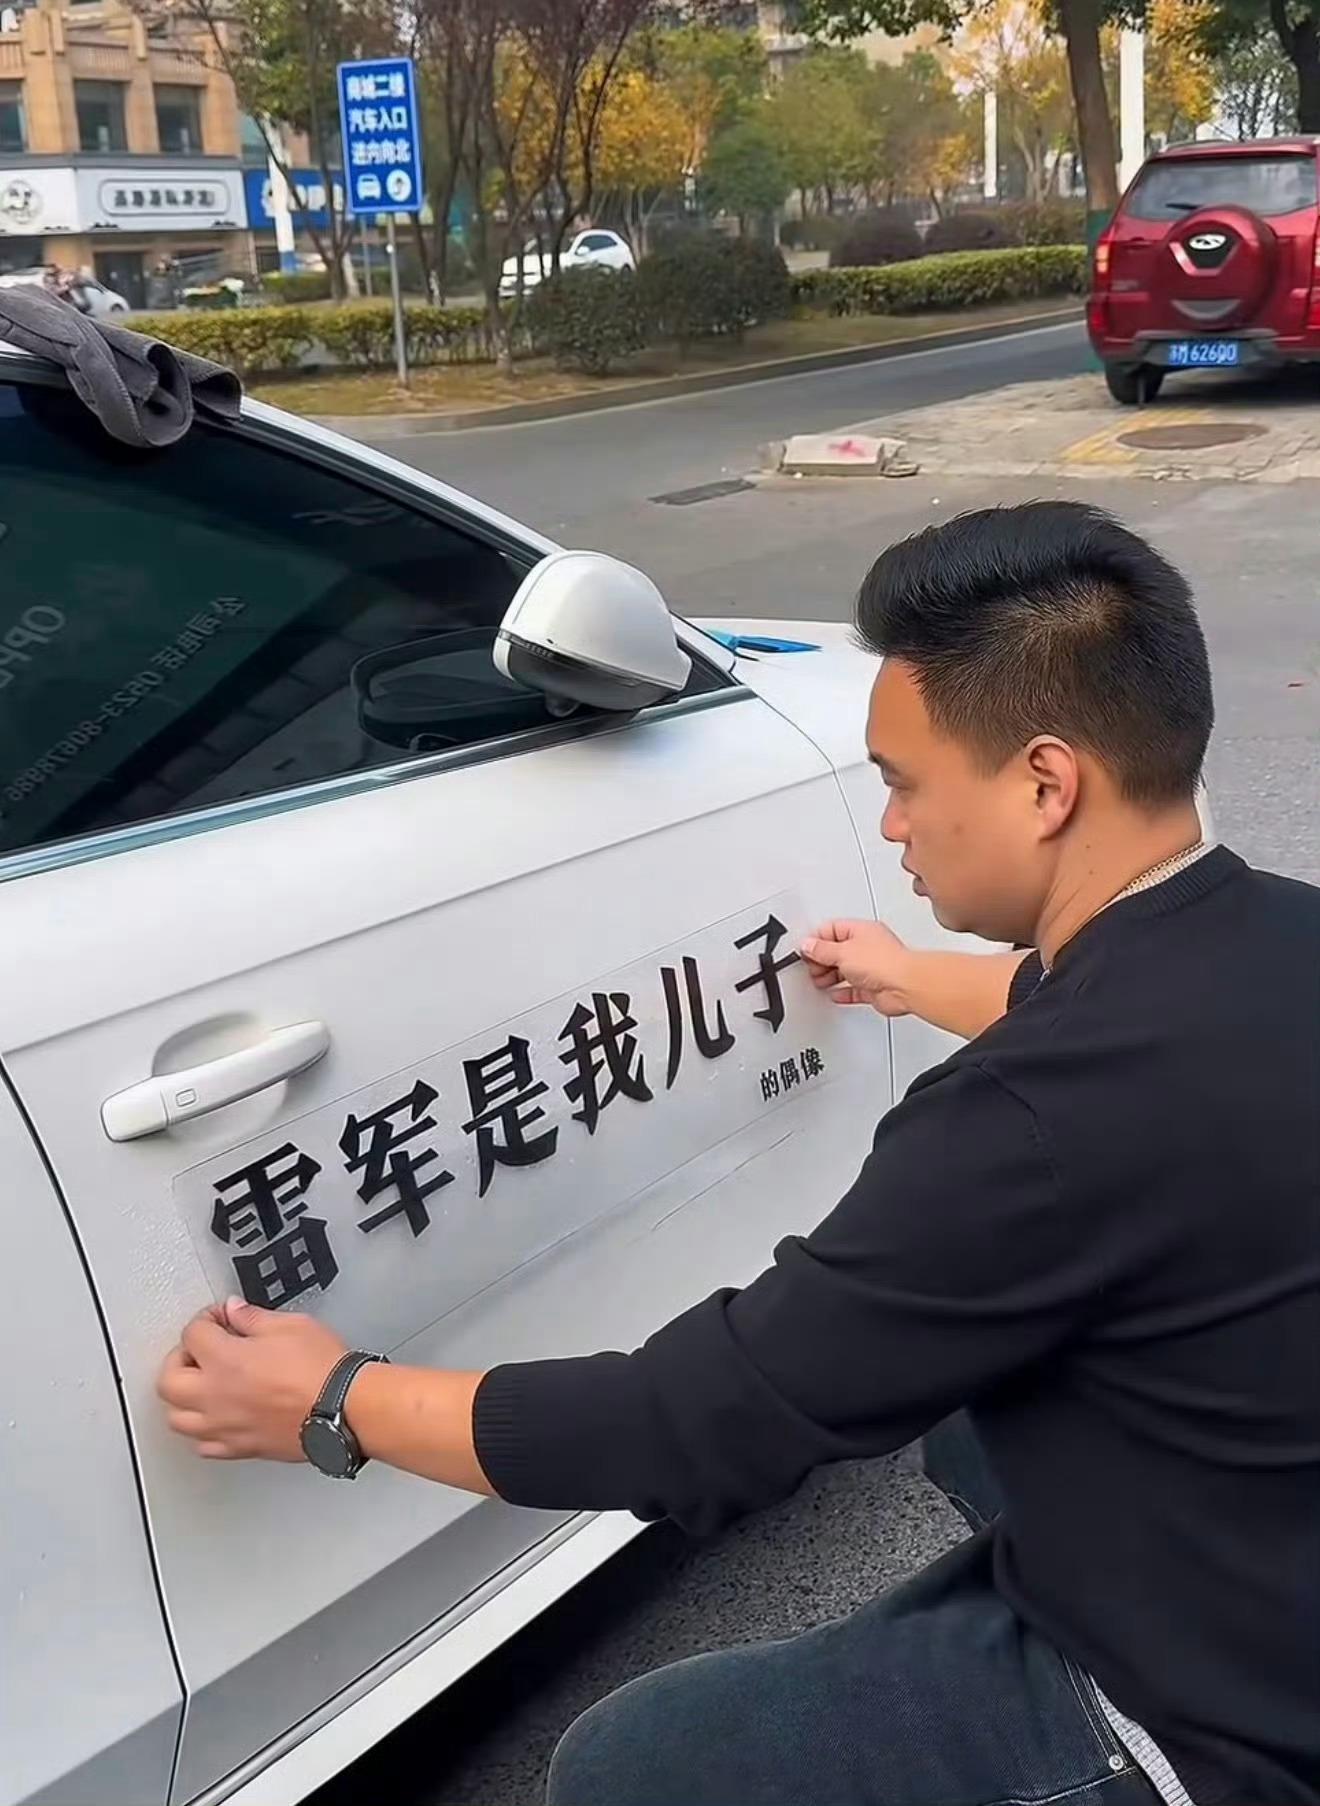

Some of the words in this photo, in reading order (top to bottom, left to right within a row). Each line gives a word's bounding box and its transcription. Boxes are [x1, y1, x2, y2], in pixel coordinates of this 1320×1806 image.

[348, 106, 407, 133] 汽车入口
[760, 1047, 824, 1102] 的偶像
[210, 914, 801, 1309] 雷军是我儿子
